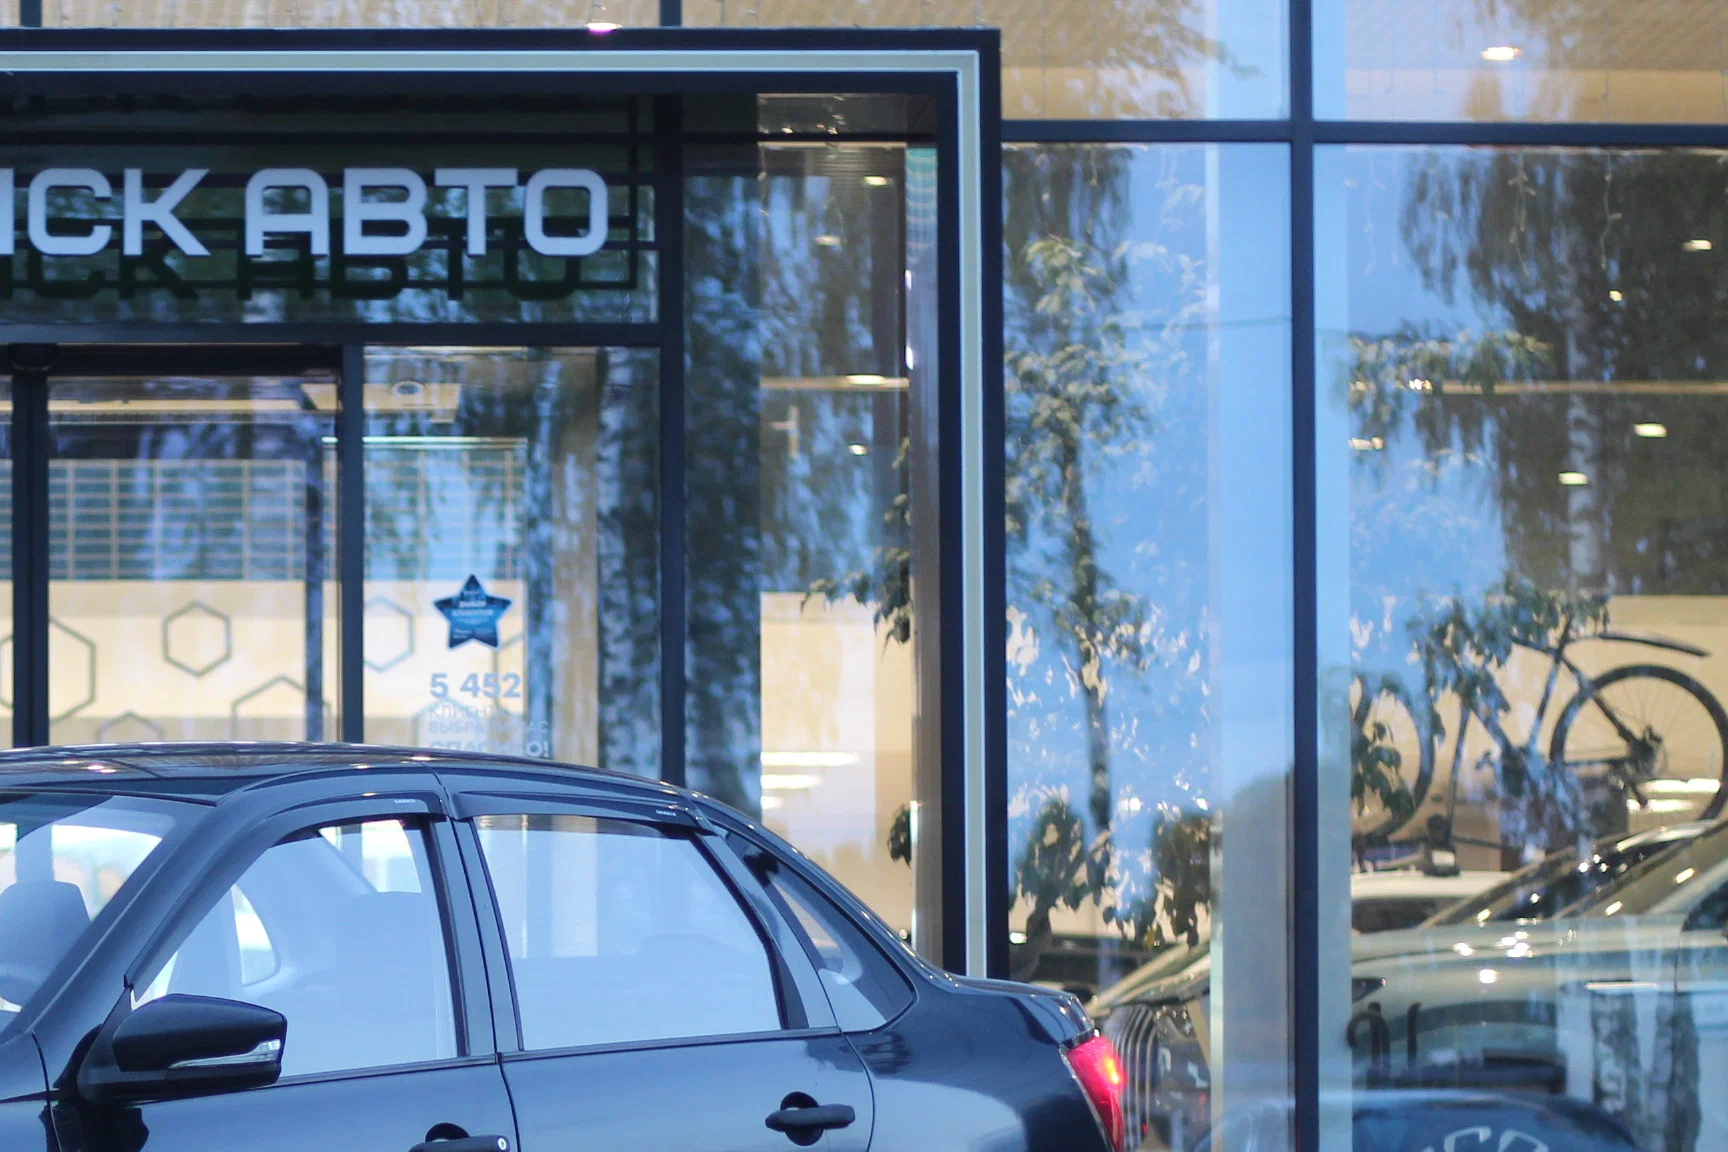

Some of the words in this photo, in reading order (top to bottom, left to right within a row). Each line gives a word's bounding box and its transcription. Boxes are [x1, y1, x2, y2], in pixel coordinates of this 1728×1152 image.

[245, 167, 610, 256] АВТО
[430, 672, 449, 699] 5
[460, 671, 522, 699] 452
